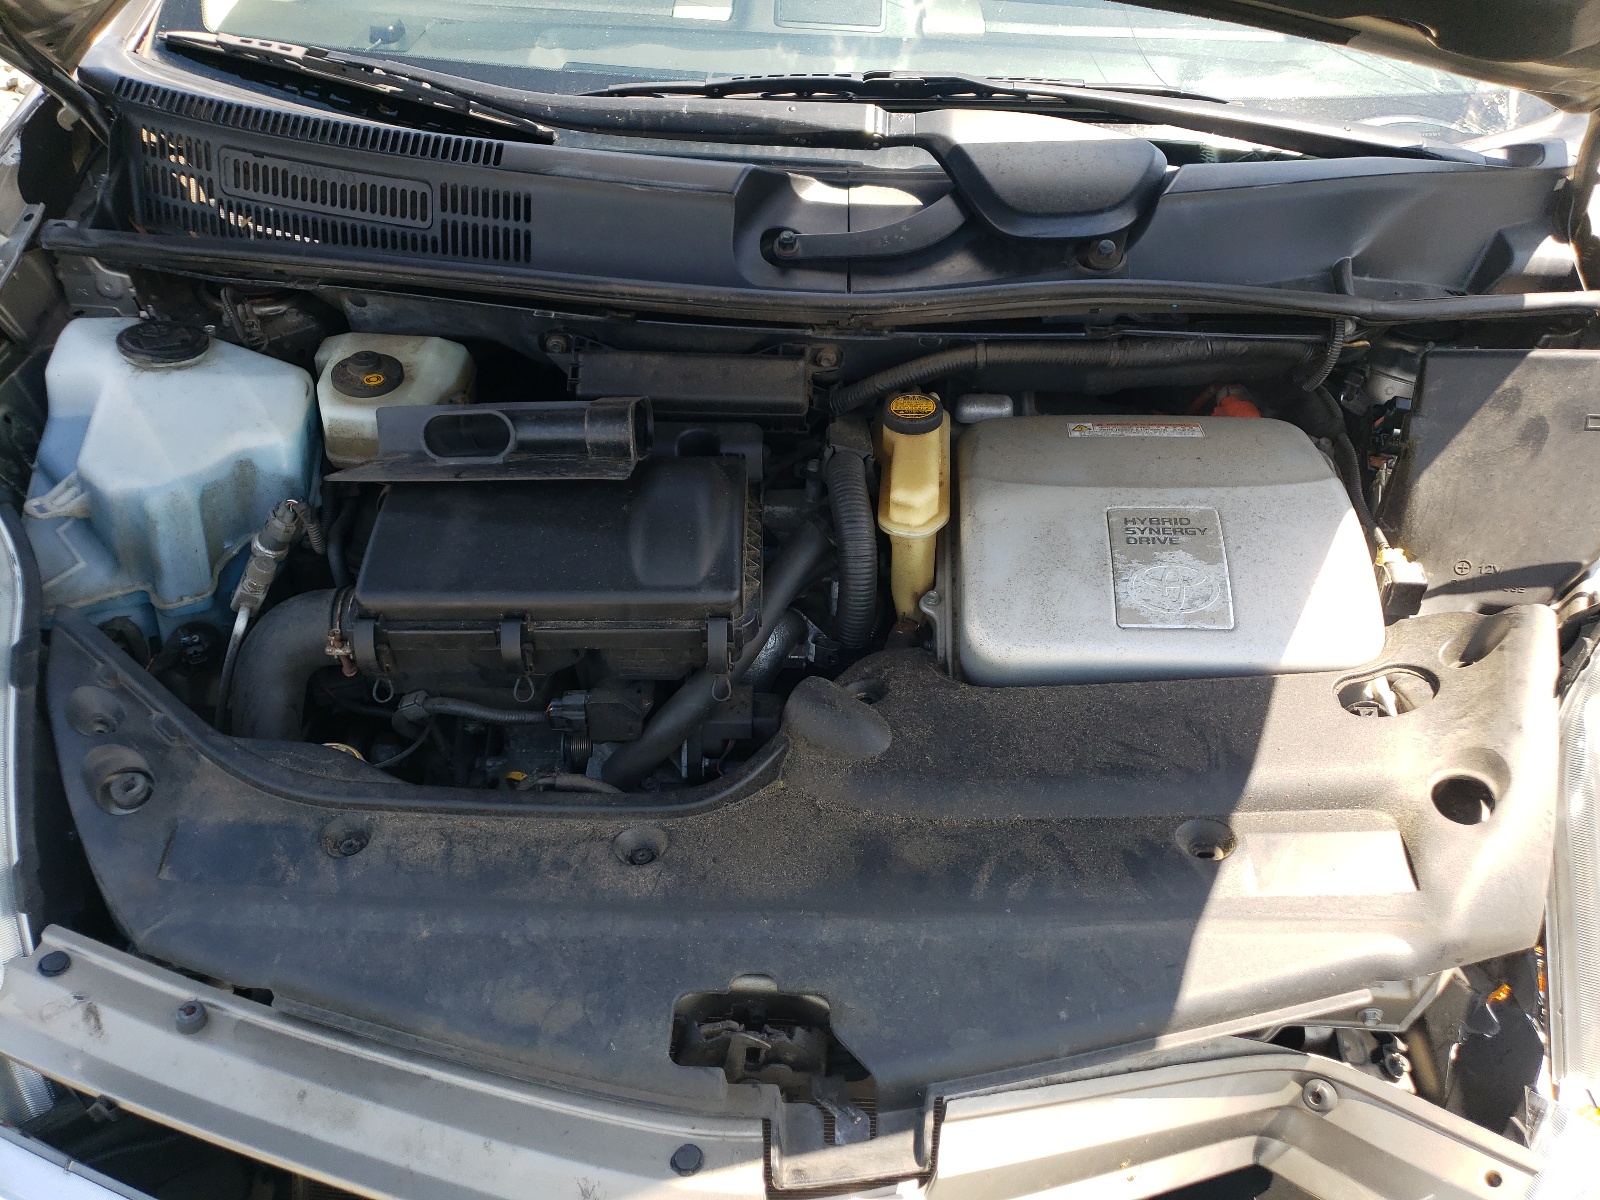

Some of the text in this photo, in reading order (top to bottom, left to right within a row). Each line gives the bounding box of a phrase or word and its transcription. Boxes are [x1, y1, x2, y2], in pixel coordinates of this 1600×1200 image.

[1123, 517, 1191, 526] HYBRID
[1124, 527, 1208, 536] SYNERGY
[1125, 536, 1181, 545] DRIVE
